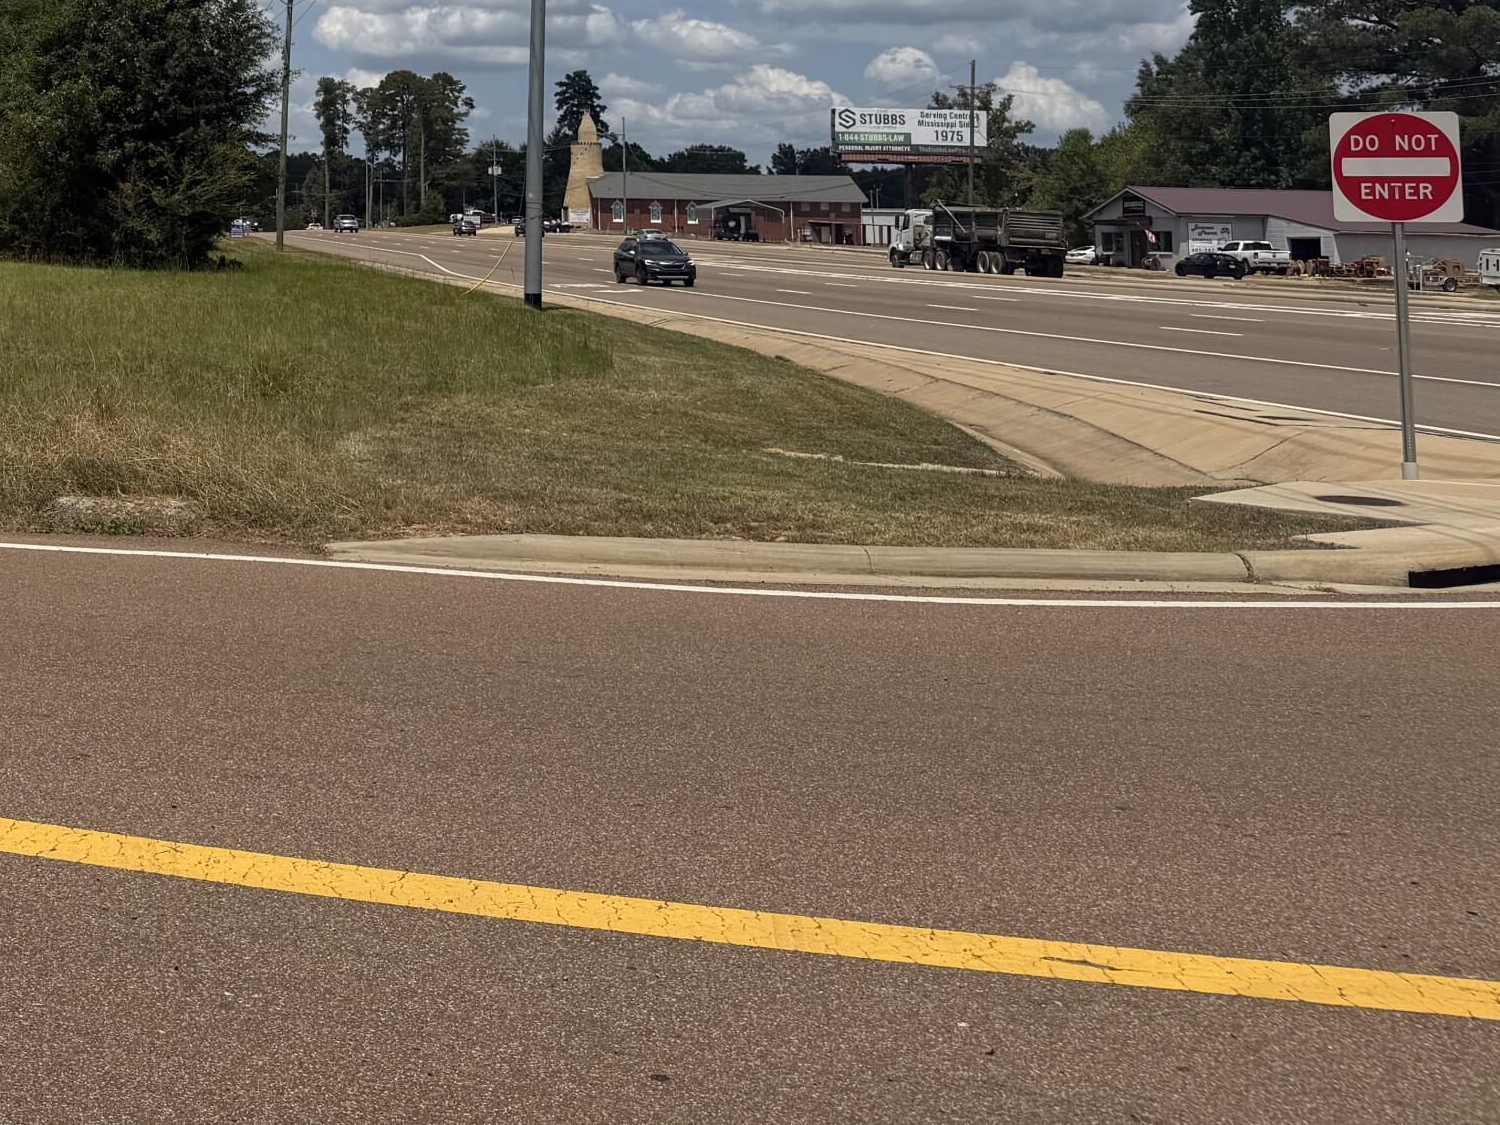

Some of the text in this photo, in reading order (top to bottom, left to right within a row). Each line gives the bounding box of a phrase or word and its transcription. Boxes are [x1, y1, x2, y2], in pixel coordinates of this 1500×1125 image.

[860, 113, 906, 125] STUBBS
[920, 111, 948, 120] Serving
[917, 119, 957, 129] Mississippi
[934, 130, 963, 142] 1975
[1350, 134, 1439, 151] DO NOT
[1360, 183, 1433, 200] ENTER
